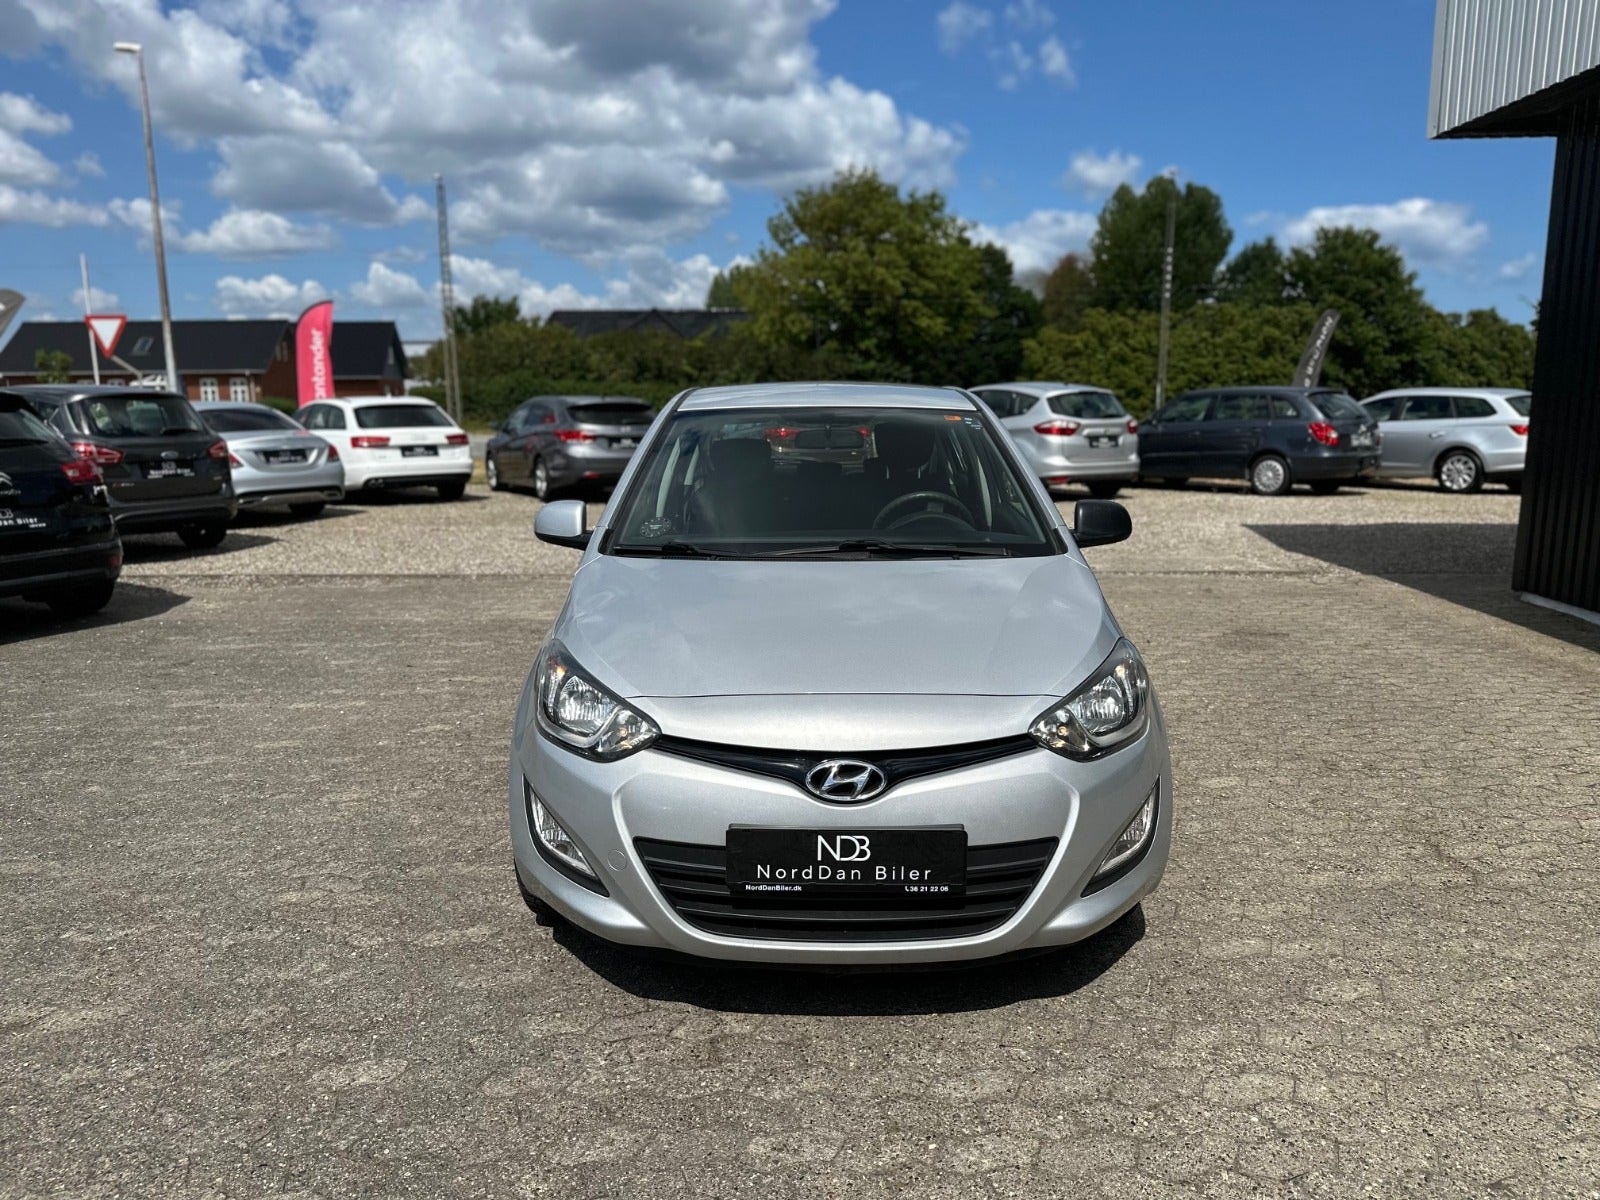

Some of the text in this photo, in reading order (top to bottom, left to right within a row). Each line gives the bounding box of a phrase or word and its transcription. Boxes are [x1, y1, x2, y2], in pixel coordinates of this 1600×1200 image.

[309, 327, 327, 400] antander
[817, 835, 871, 862] NDB
[757, 864, 932, 881] NordDan Biler
[745, 884, 803, 892] NordDanBiler.dk
